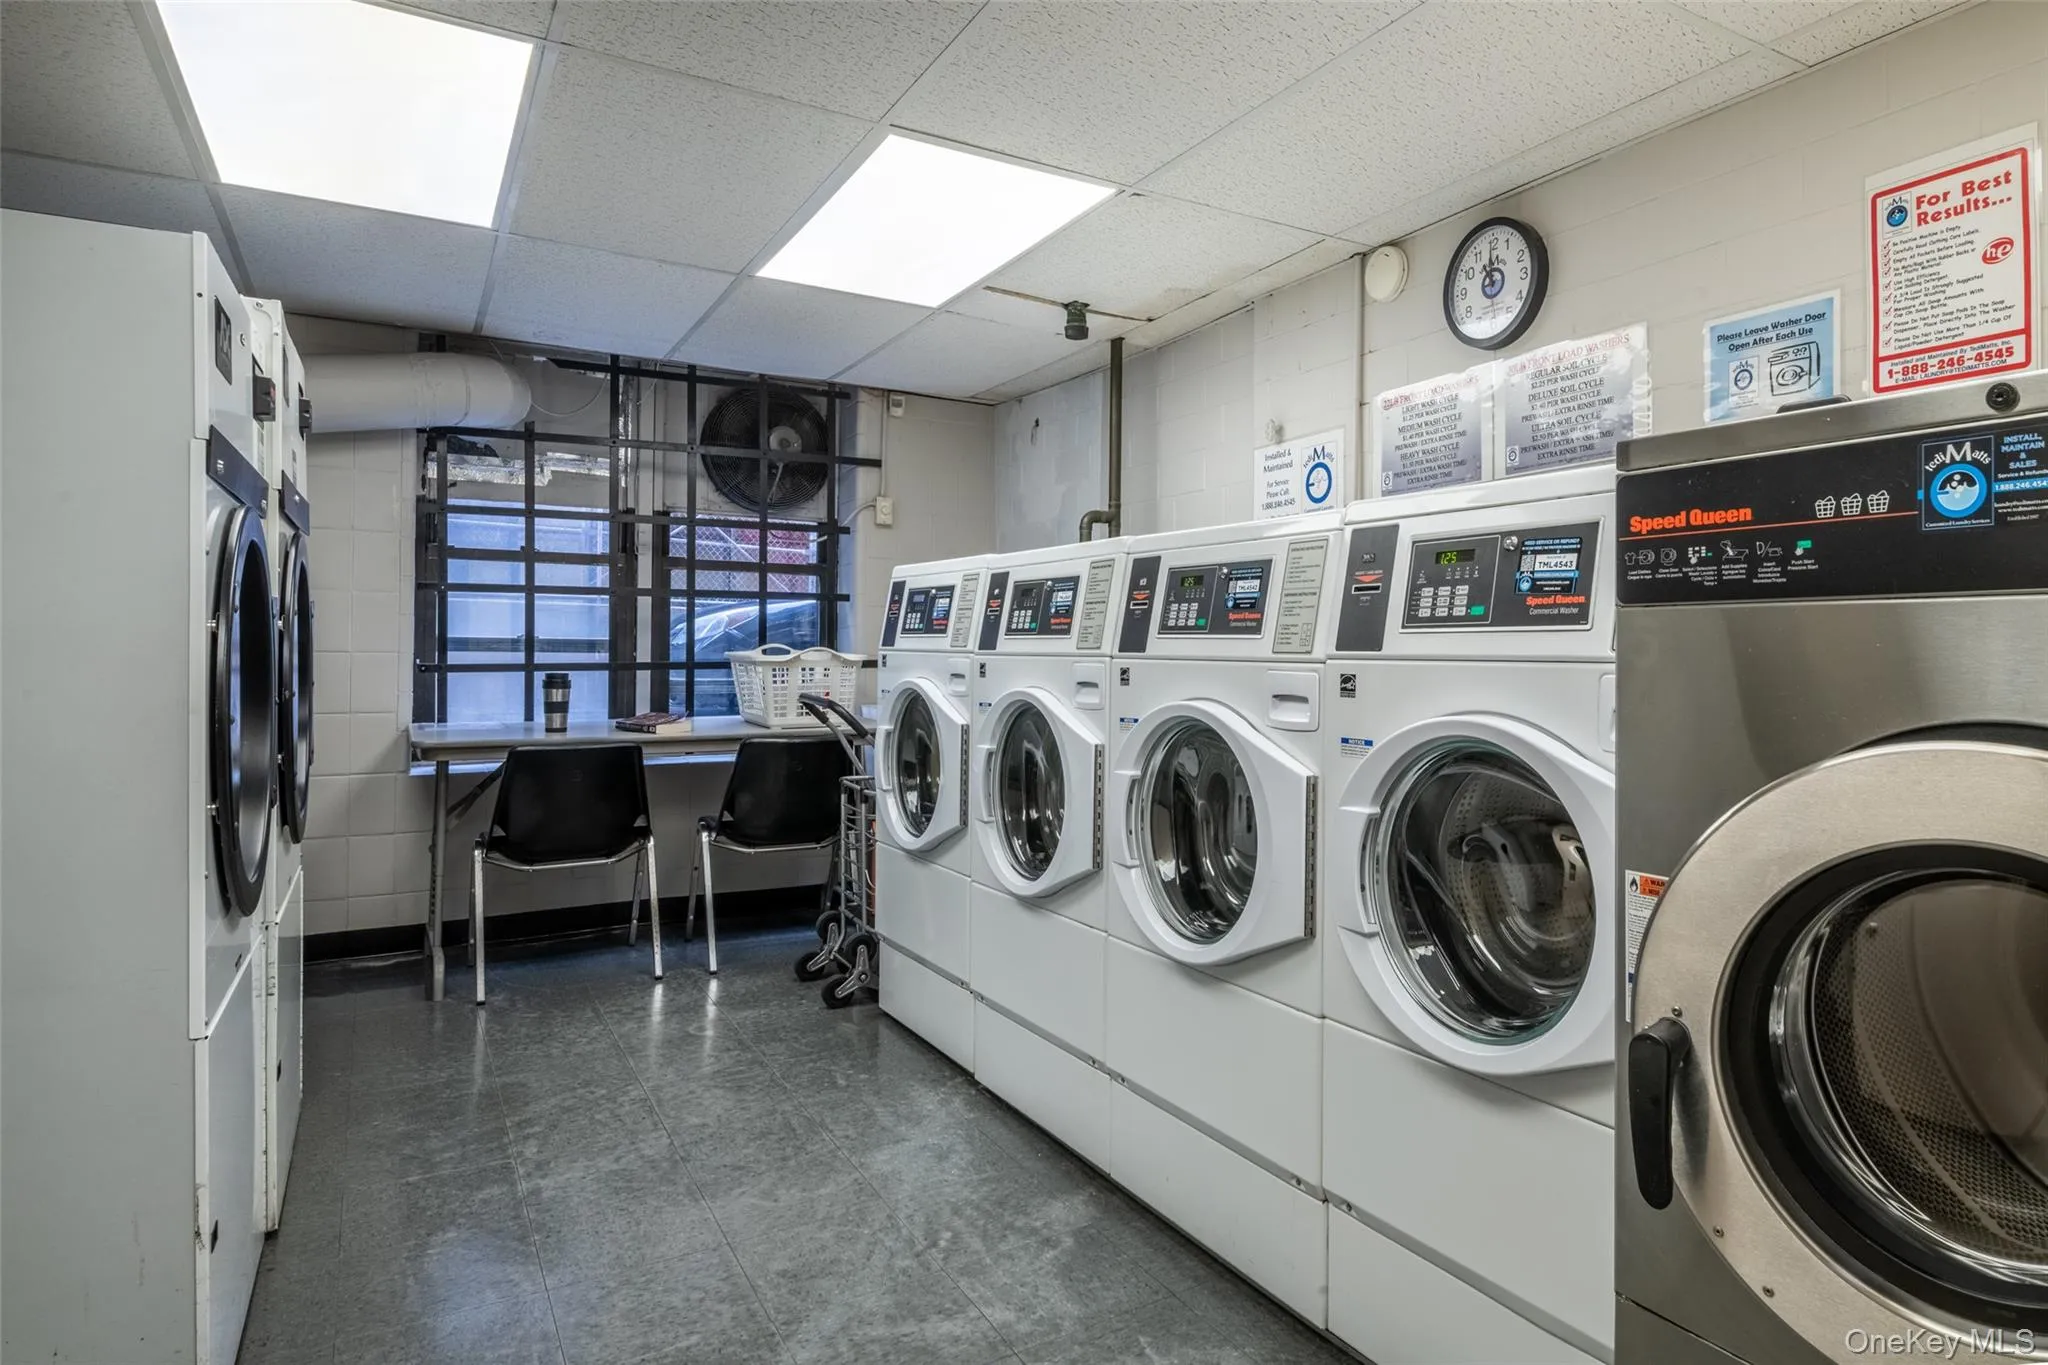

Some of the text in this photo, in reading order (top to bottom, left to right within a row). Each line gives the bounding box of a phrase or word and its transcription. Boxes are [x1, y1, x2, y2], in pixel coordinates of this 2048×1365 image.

[1915, 190, 1951, 210] For
[1962, 170, 2012, 196] Best
[1917, 196, 2012, 227] Results...
[1919, 231, 1937, 239] Machine
[1946, 225, 1961, 234] Empty
[1505, 237, 1510, 250] 1
[1893, 246, 1913, 256] Carefully
[1929, 237, 1948, 247] Clothing
[1917, 244, 1953, 257] Pockets Before
[1474, 251, 1482, 264] 11
[1517, 249, 1525, 264] 2
[1938, 252, 1954, 261] Rubber
[1464, 266, 1475, 281] 10
[1520, 266, 1529, 280] 3
[1917, 271, 1940, 280] Efficiency
[1910, 273, 1983, 295] Load Strongly Suggested
[1460, 287, 1468, 300] 9
[1904, 294, 1921, 303] Proper
[1924, 288, 1946, 297] Washing
[1944, 292, 1967, 302] Amounts
[1969, 287, 1984, 295] With
[1465, 305, 1472, 319] 8
[1940, 315, 1961, 325] Directly
[1993, 303, 2016, 313] Washer
[1956, 299, 2005, 314] Pods Soap
[1717, 312, 1826, 342] Please Leave Washer Door
[1946, 321, 1976, 333] More Than
[1728, 326, 1813, 352] Open After Each Use
[1894, 331, 1964, 350] Liquid/Powder Detergent
[1887, 345, 2014, 379] 1-888-246-4545
[1890, 357, 1913, 367] Installed
[1915, 354, 1926, 362] and
[1927, 349, 1958, 360] Maintained
[1960, 347, 1967, 355] By
[1563, 360, 1579, 372] SOIL
[1920, 358, 2007, 379] LAUNDRY@TEDIMATTS.COM
[1546, 374, 1560, 385] PER
[1560, 371, 1578, 382] WASH
[1528, 377, 1605, 401] DELUXE SOIL CYCLE
[1420, 398, 1438, 408] WASH
[1546, 390, 1601, 408] PER WASH CYCLE
[1554, 396, 1615, 417] EXTRA RINSE TIME
[1414, 403, 1457, 420] PER WASH CYCLE
[1557, 417, 1574, 427] SOIL
[1575, 411, 1603, 424] CYCLE
[1398, 412, 1462, 434] MEDIUM WASH CYCLE
[1414, 423, 1457, 440] PER WASH CYCLE
[1547, 430, 1559, 441] PER
[1394, 430, 1467, 452] PREWASH EXTRA RINSE TIME
[1520, 438, 1575, 454] PREWASH EXTRA
[2001, 440, 2045, 453] MAINTAIN
[1265, 449, 1287, 462] Installed
[1400, 441, 1460, 461] HEAVY WASH CYCLE
[1537, 450, 1558, 461] EXTRA
[1559, 447, 1578, 457] RINSE
[1579, 444, 1595, 454] TIME
[1263, 460, 1293, 473] Maintained
[1414, 452, 1457, 467] PER WASH CYCLE
[2008, 459, 2037, 469] SALES
[1420, 465, 1436, 473] EXTRA
[1437, 462, 1453, 471] WASH
[1407, 477, 1424, 485] EXTRA
[1440, 471, 1453, 479] TIME
[1995, 480, 2048, 491] 1.888.246.454
[1630, 507, 1752, 534] Speed Queen
[1952, 518, 1971, 526] Laundry
[1538, 561, 1574, 569] TML4543
[1526, 594, 1585, 607] Speed Queen
[1228, 612, 1245, 621] Speed
[1529, 606, 1579, 616] Commercial Washer
